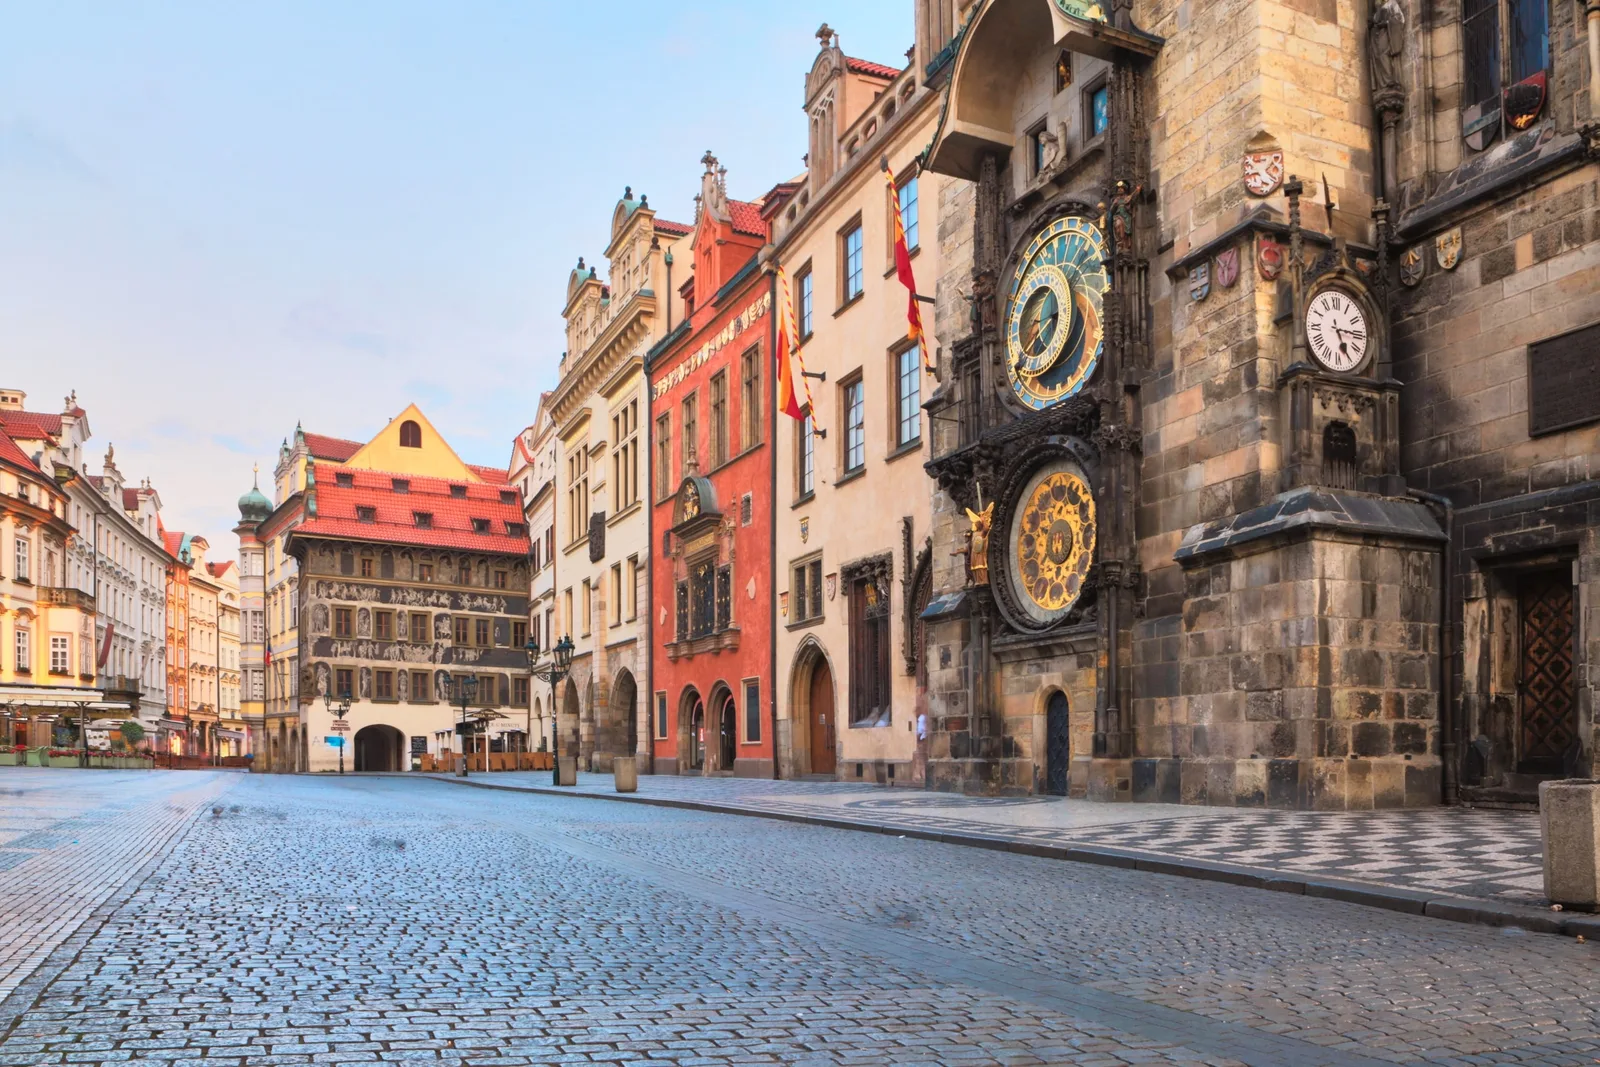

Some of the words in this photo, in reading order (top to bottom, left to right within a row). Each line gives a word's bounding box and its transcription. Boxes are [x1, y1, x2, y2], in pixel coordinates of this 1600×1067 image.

[1321, 298, 1330, 312] XI
[1332, 296, 1340, 310] XII
[1344, 304, 1350, 314] I
[1313, 308, 1324, 319] X
[1311, 322, 1321, 331] IX
[1350, 316, 1360, 325] II
[1352, 330, 1362, 340] III
[1313, 334, 1325, 350] VIII
[1350, 341, 1361, 356] IV
[1321, 345, 1333, 362] VII
[1335, 352, 1342, 365] VI
